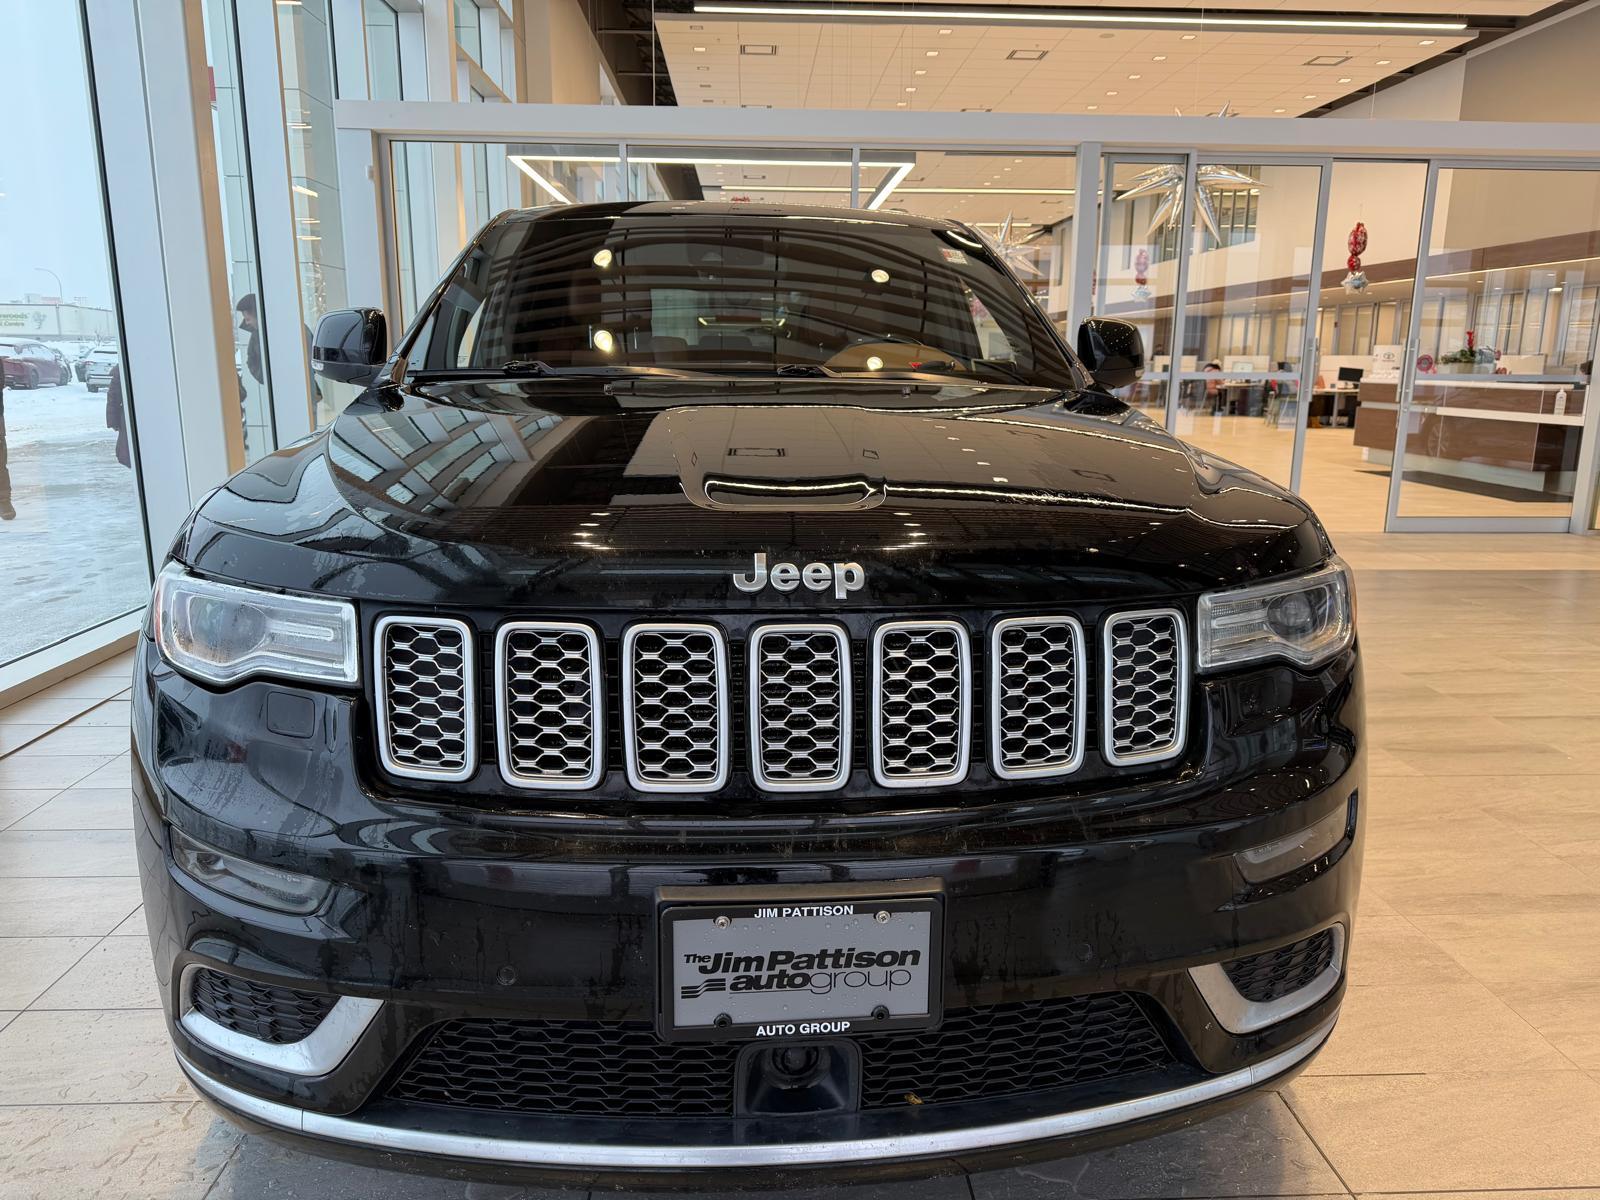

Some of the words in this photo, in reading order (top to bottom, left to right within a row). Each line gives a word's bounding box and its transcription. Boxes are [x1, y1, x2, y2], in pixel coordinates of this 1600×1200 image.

[733, 552, 865, 600] Jeep
[754, 907, 778, 919] JIM
[782, 905, 854, 917] PATTISON
[684, 953, 712, 964] The
[698, 951, 765, 975] Jim
[766, 947, 921, 972] Pattison
[756, 1024, 796, 1036] AUTO
[799, 1021, 851, 1034] GROUP
